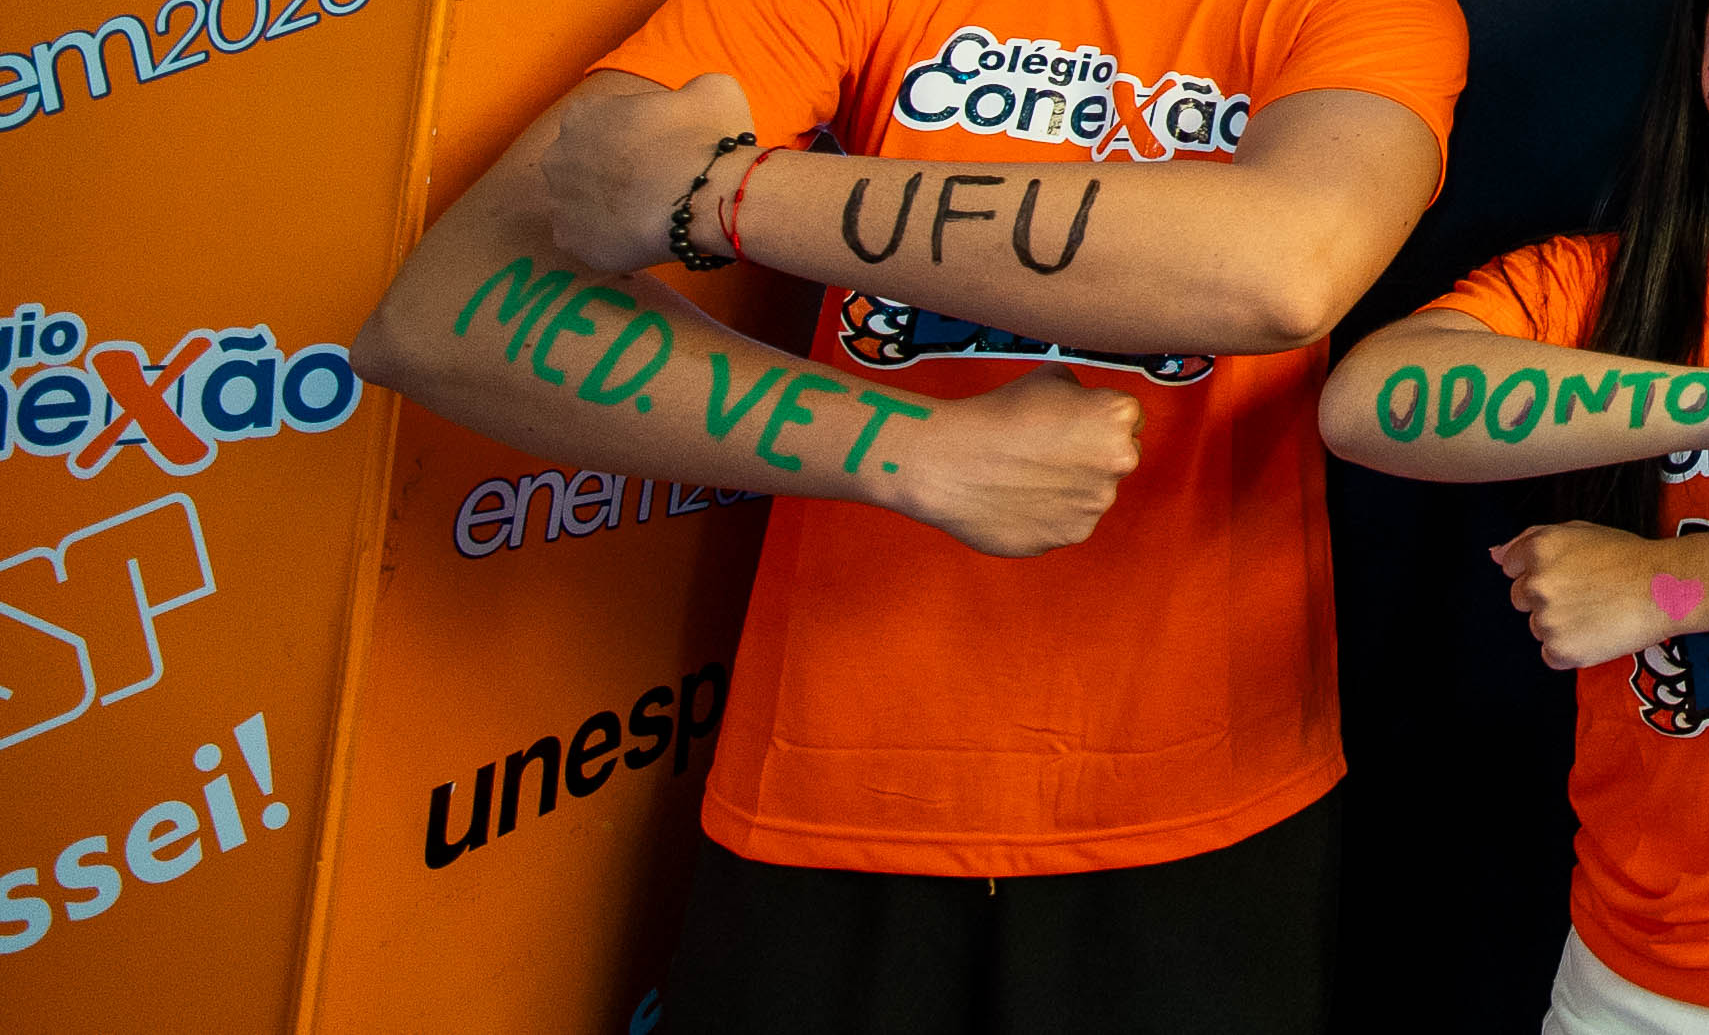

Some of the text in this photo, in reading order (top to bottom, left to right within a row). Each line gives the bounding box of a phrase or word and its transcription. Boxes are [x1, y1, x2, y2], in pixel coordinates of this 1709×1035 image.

[942, 32, 1114, 87] Colégio
[842, 172, 1100, 275] UFU
[453, 256, 934, 474] MED. VET.
[0, 492, 217, 750] SP
[0, 711, 291, 955] ssei!
[425, 661, 728, 870] unesp
